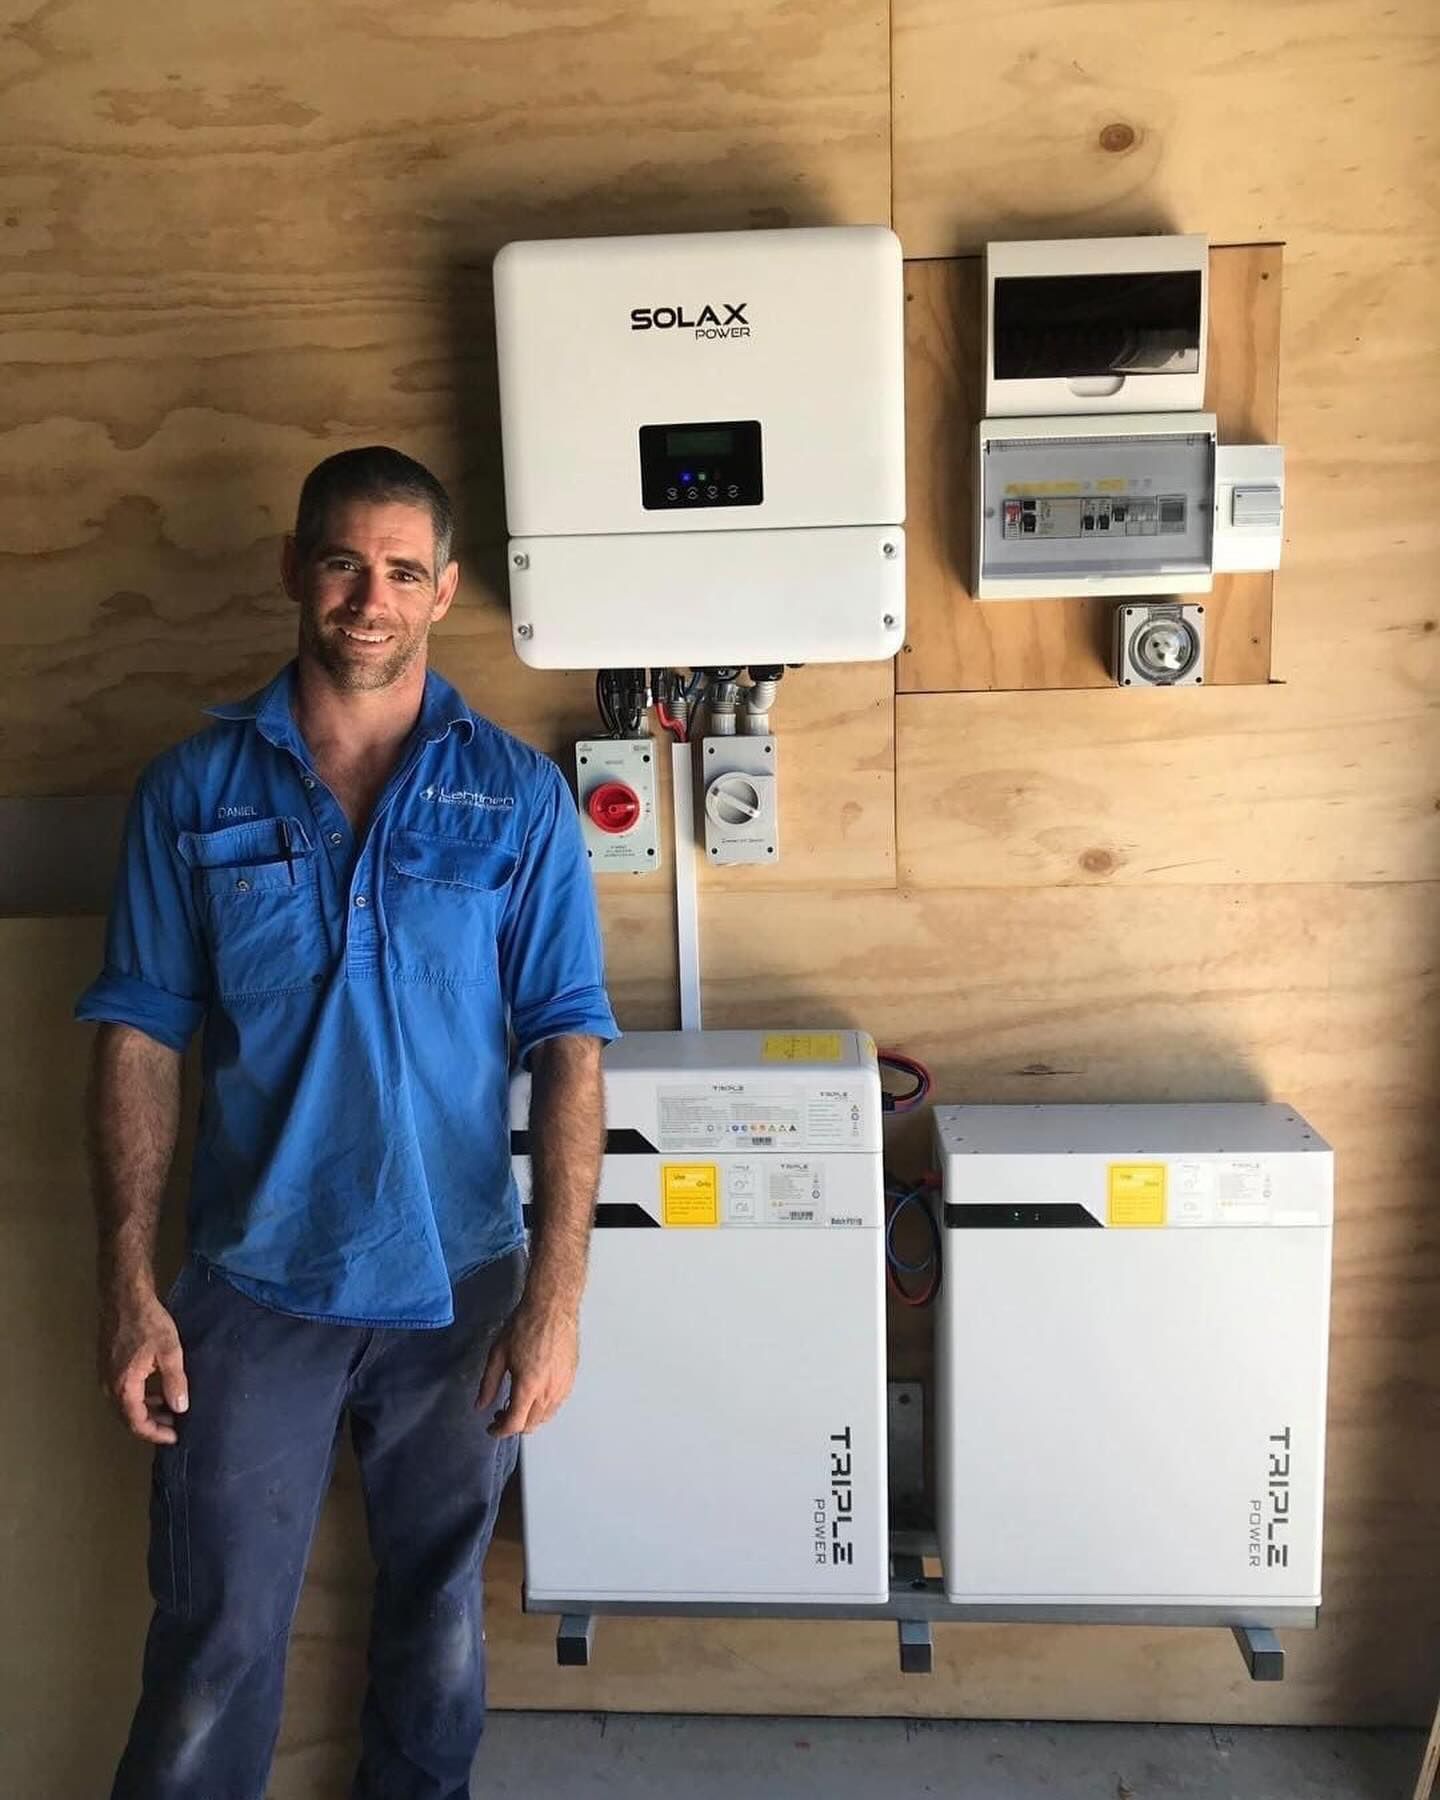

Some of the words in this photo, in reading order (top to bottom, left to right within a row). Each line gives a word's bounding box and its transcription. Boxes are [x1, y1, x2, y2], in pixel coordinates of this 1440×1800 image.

[631, 303, 749, 330] SOLAX
[695, 327, 751, 340] POWER
[217, 806, 257, 819] DANIEL
[830, 1426, 853, 1565] TRIPLE
[1267, 1426, 1290, 1567] TRIPLE
[814, 1498, 827, 1564] POWER
[1249, 1499, 1262, 1567] POWER
